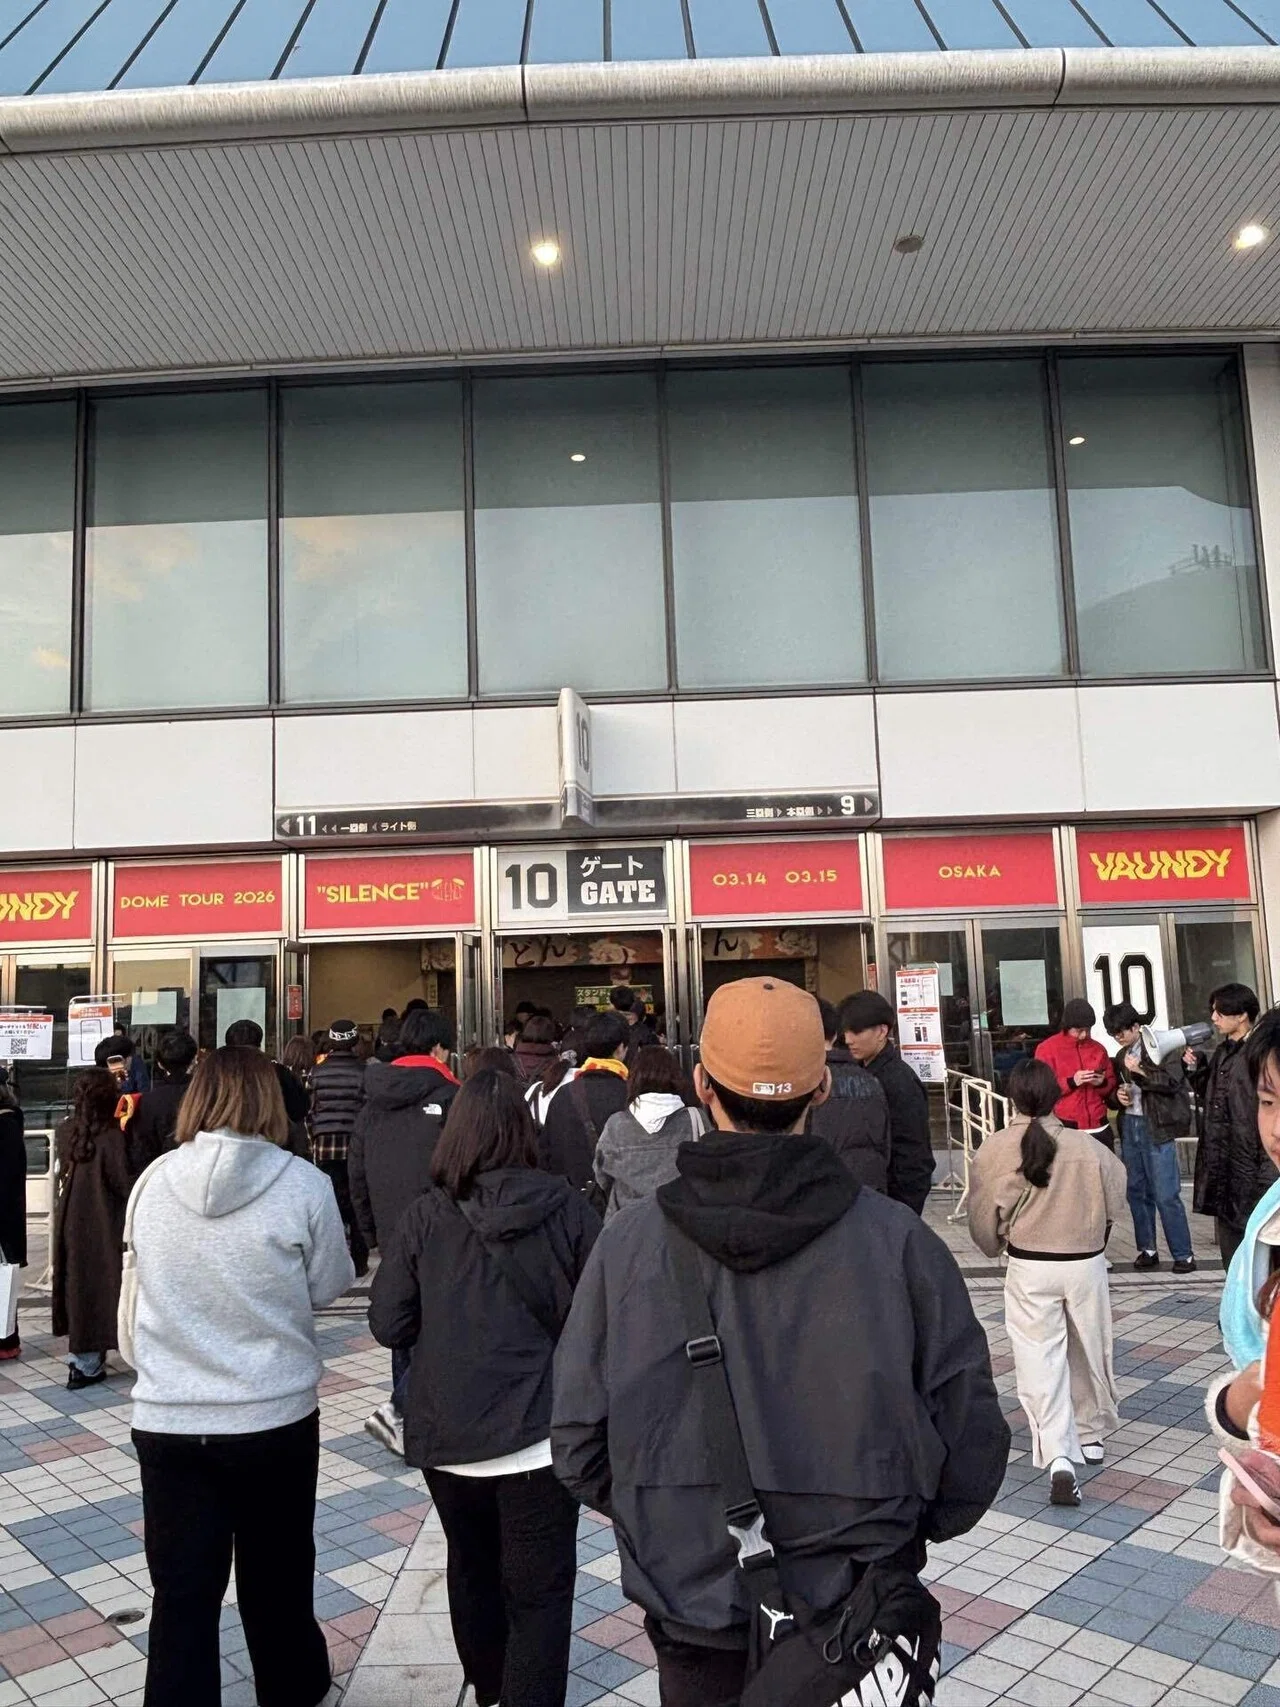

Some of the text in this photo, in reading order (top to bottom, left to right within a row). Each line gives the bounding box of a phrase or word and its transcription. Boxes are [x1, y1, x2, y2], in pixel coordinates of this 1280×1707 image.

[840, 795, 855, 815] 9
[296, 815, 316, 836] 11
[580, 855, 644, 878] ゲート
[938, 864, 1001, 878] OSAKA
[1089, 848, 1233, 881] VAUNDY
[505, 863, 558, 910] 10
[712, 870, 838, 886] 03.14 03.15
[120, 891, 275, 909] DOME TOUR 2026
[317, 882, 429, 903] "SILENCE"
[580, 879, 656, 906] GATE
[1093, 952, 1158, 1028] 10
[776, 1083, 792, 1094] 13
